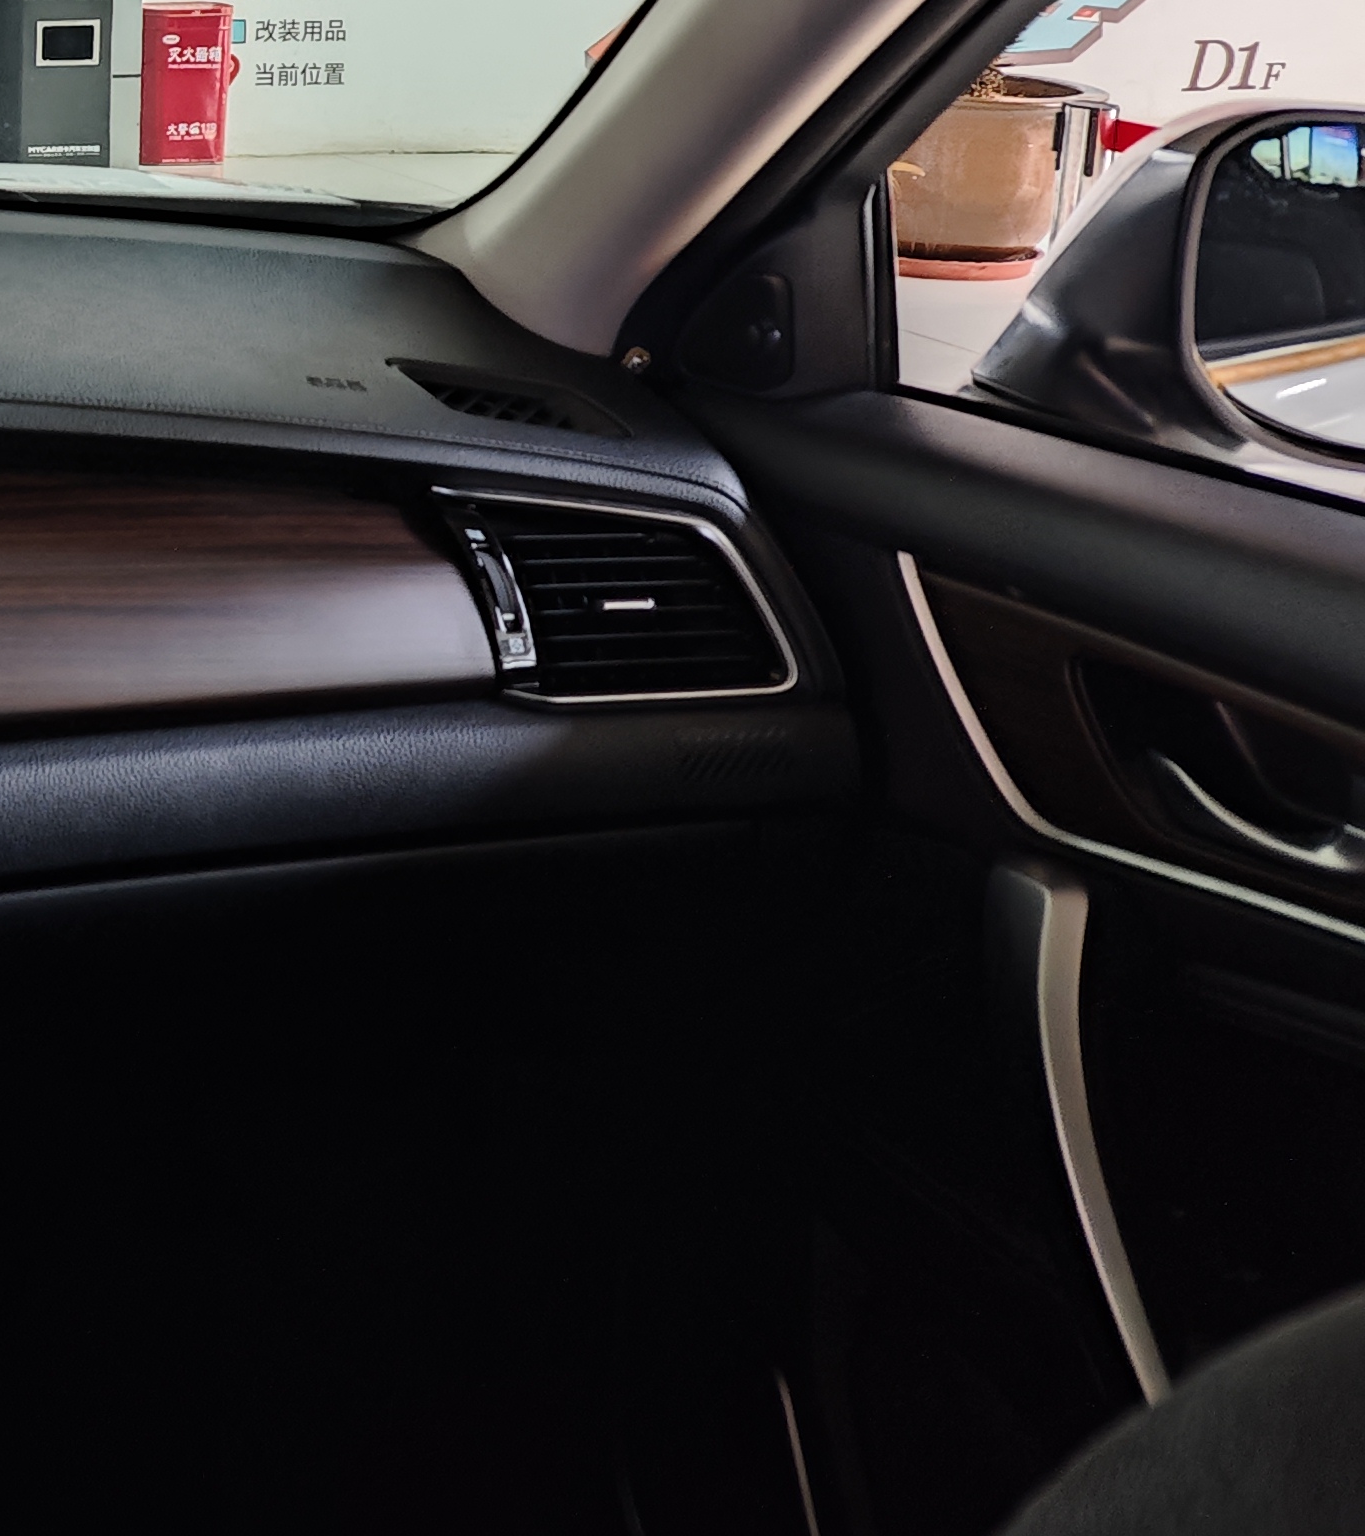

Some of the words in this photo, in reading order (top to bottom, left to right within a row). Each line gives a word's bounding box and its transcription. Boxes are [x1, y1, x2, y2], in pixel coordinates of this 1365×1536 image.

[255, 19, 347, 44] 改装用品
[255, 63, 345, 88] 当前位置
[1181, 39, 1287, 92] D1F
